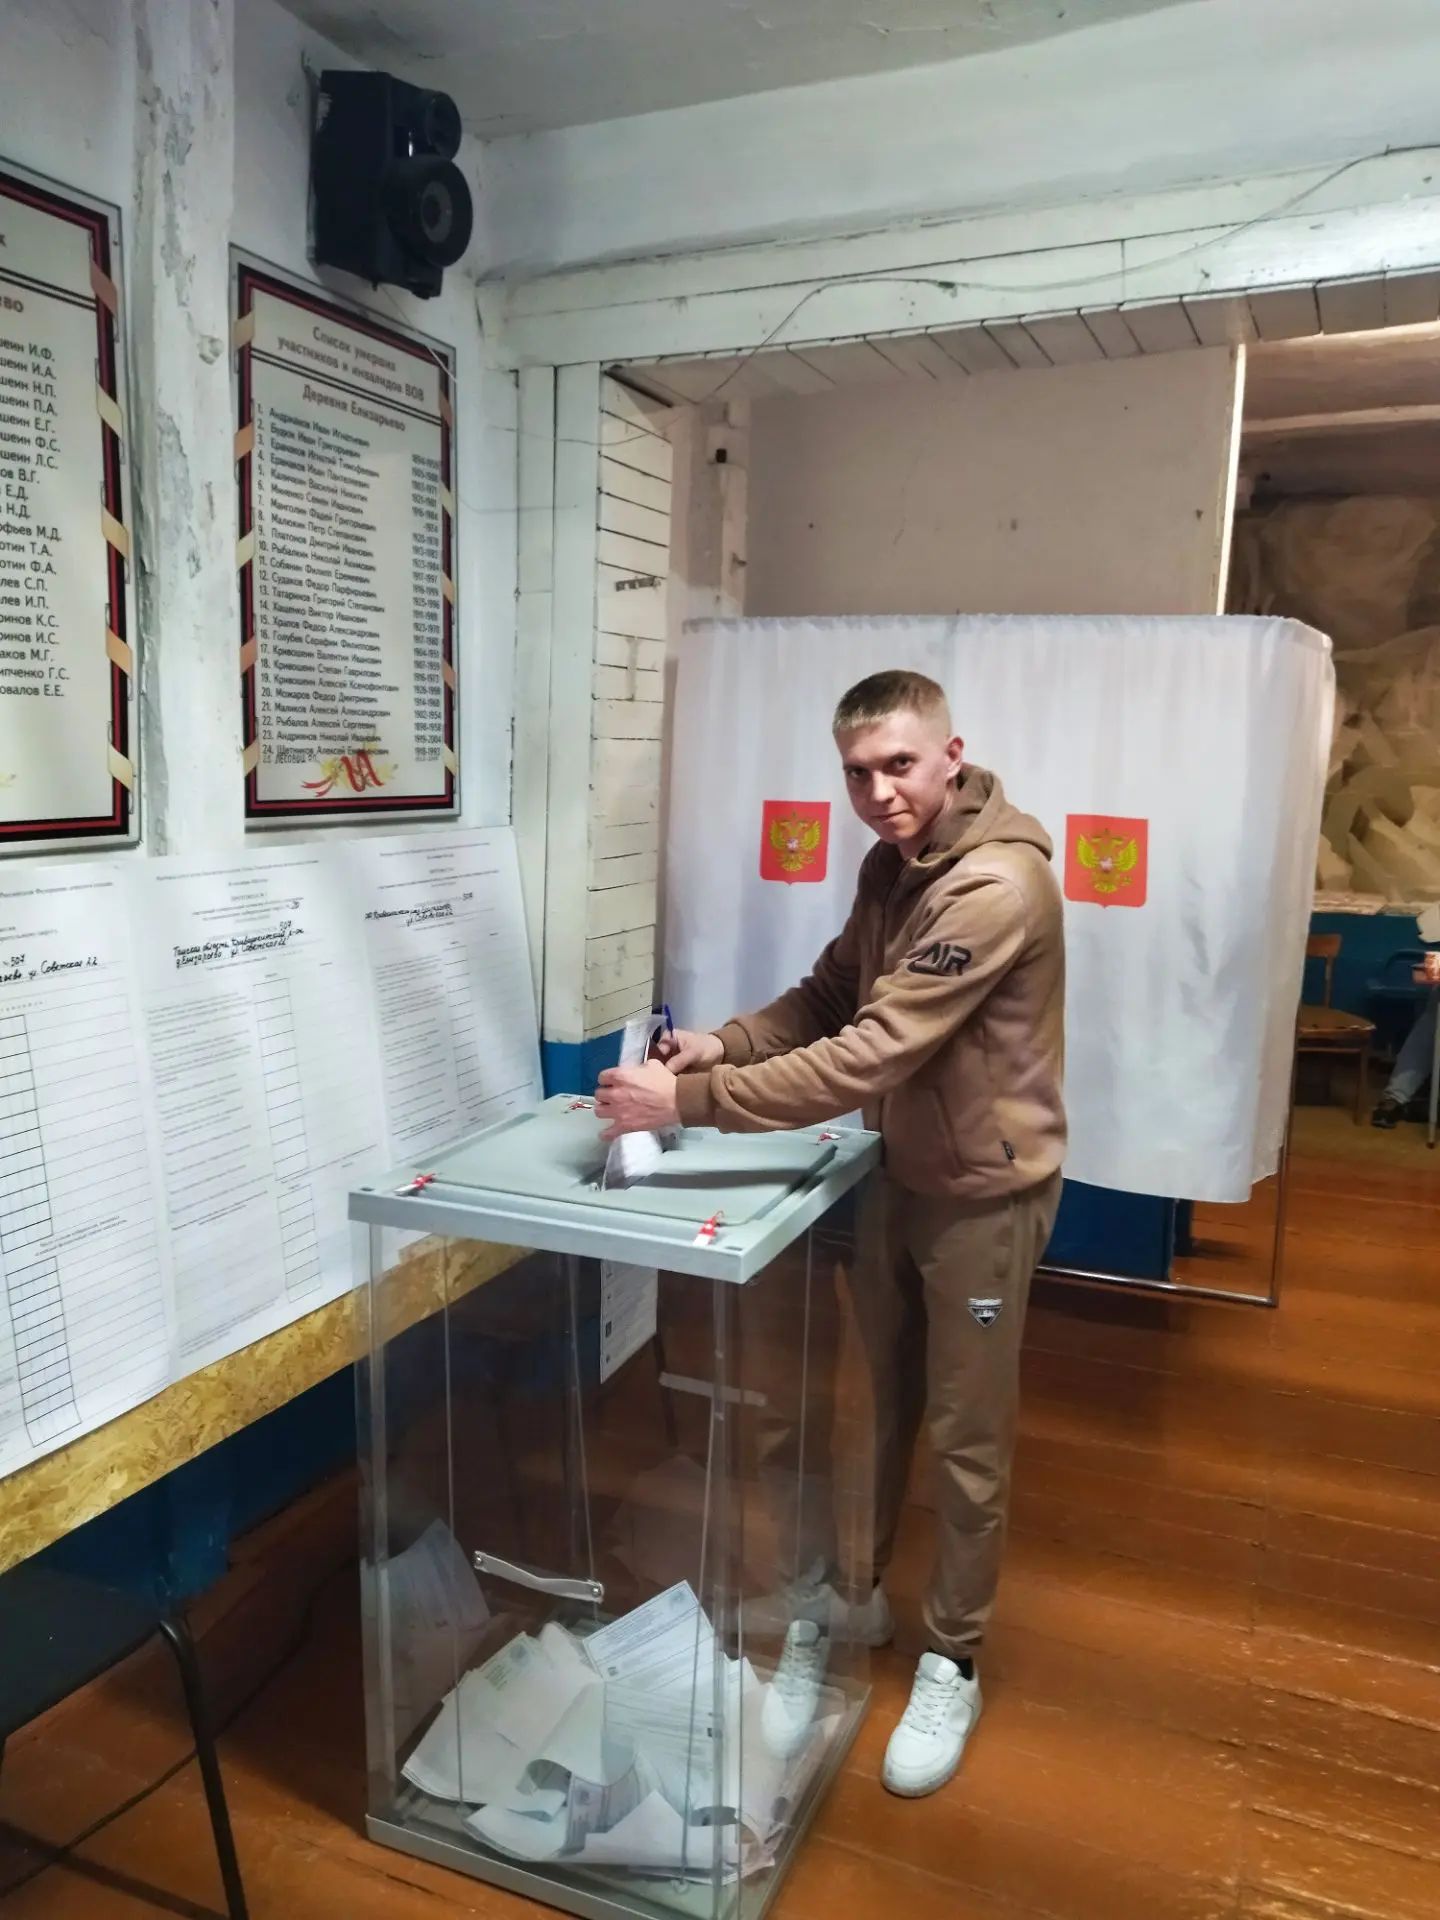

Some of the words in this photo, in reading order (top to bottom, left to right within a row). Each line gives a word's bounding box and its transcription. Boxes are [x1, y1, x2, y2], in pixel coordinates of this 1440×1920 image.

[312, 326, 351, 353] Список
[28, 343, 55, 361] И.Ф.
[31, 361, 56, 379] И.А.
[33, 381, 56, 397] Н.П.
[405, 383, 425, 402] ВОВ
[34, 399, 57, 416] П.А.
[303, 384, 348, 412] Деревня
[350, 400, 406, 432] Елизарьево
[34, 417, 55, 433] Е.Г.
[35, 436, 61, 452] Ф.С.
[35, 454, 58, 469] Л.С.
[18, 468, 40, 484] В.Г.
[5, 484, 28, 501] Е.Д.
[6, 502, 30, 519] Н.Д.
[36, 525, 61, 541] М.Д.
[30, 541, 53, 556] Т.А.
[30, 560, 56, 575] Ф.А.
[24, 577, 48, 591] С.П.
[25, 595, 49, 609] И.П.
[36, 613, 59, 627] К.С.
[35, 631, 59, 644] И.С.
[30, 648, 53, 662] М.Г.
[48, 667, 70, 680] Г.С.
[43, 684, 64, 697] Е.Е.
